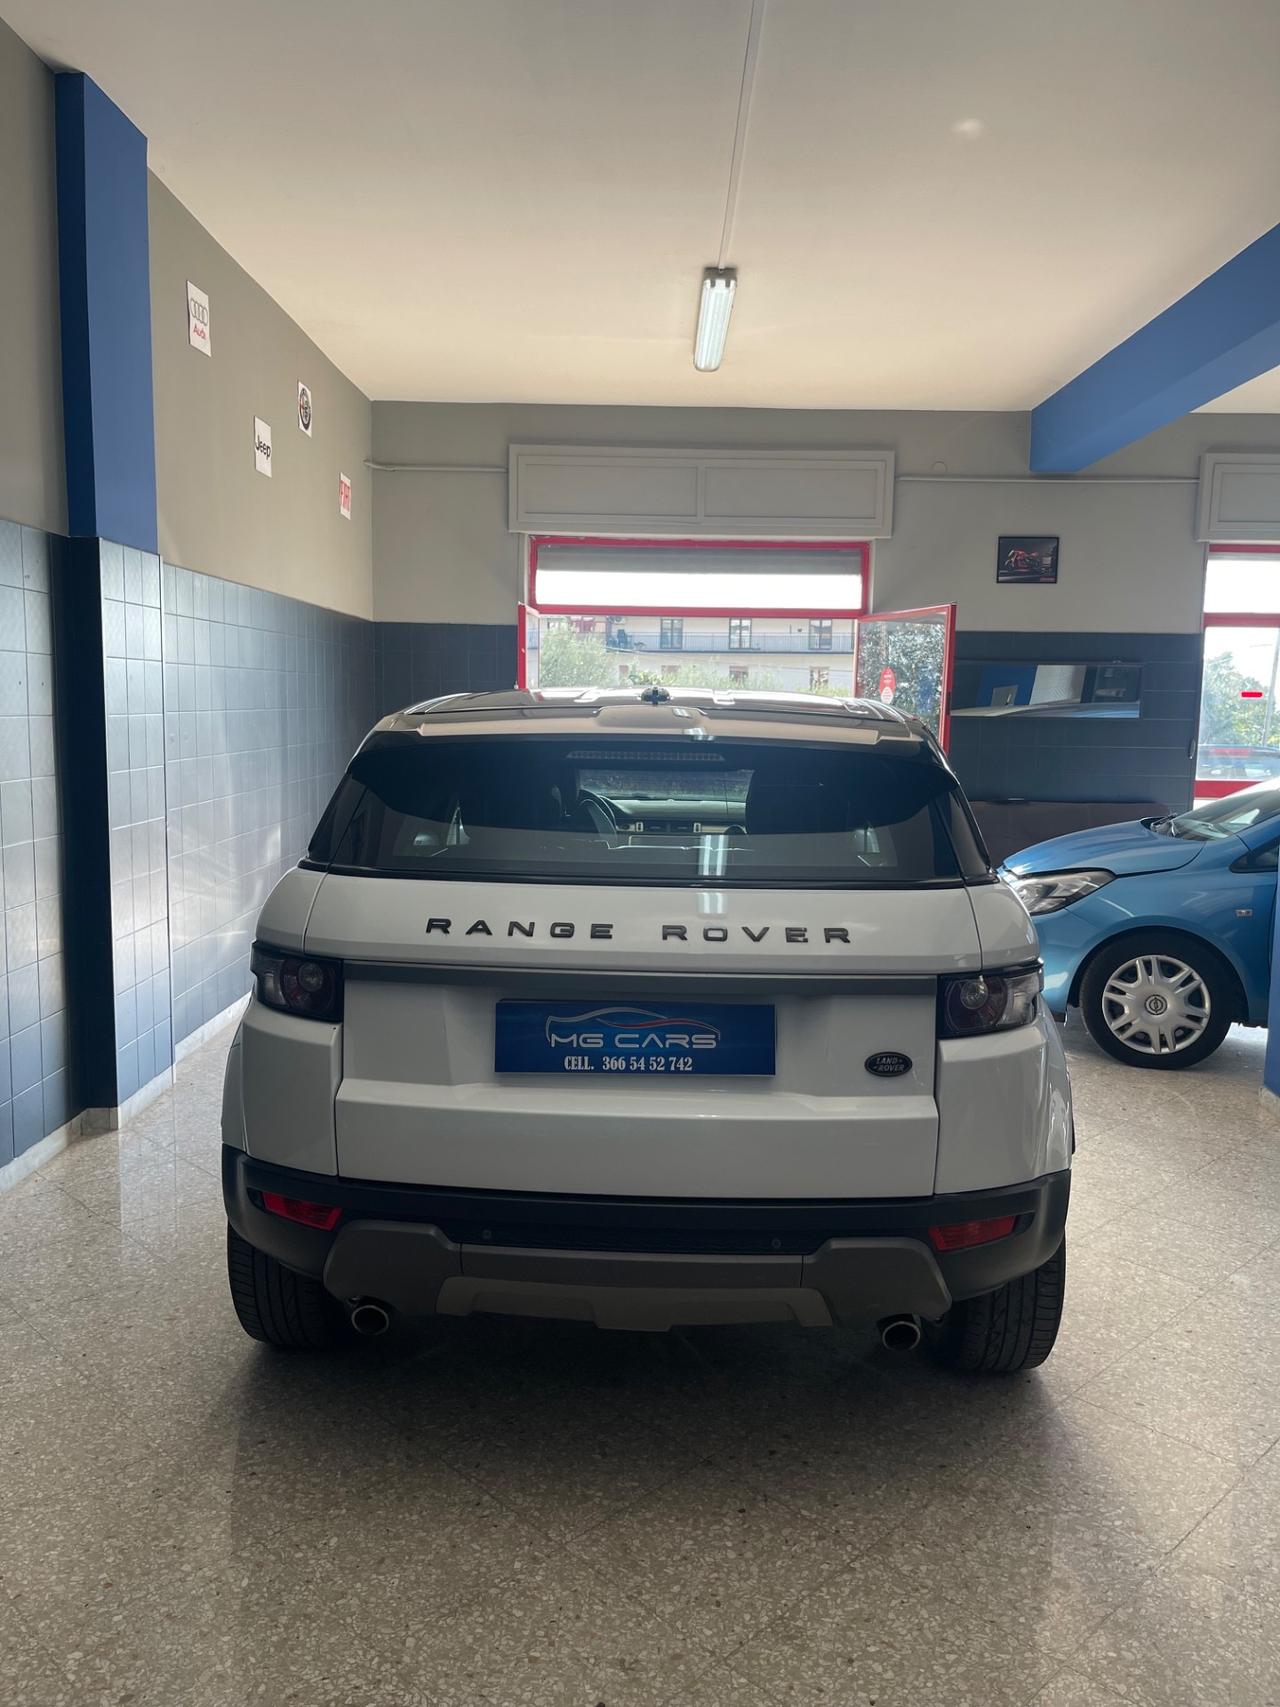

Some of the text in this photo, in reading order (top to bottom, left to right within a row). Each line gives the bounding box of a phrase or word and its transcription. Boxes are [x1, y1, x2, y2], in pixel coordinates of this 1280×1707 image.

[256, 435, 271, 460] Jeep
[426, 917, 851, 944] RANGE ROVER
[551, 1033, 717, 1049] MG CARS
[564, 1056, 693, 1071] CELL. 366 54 52 742
